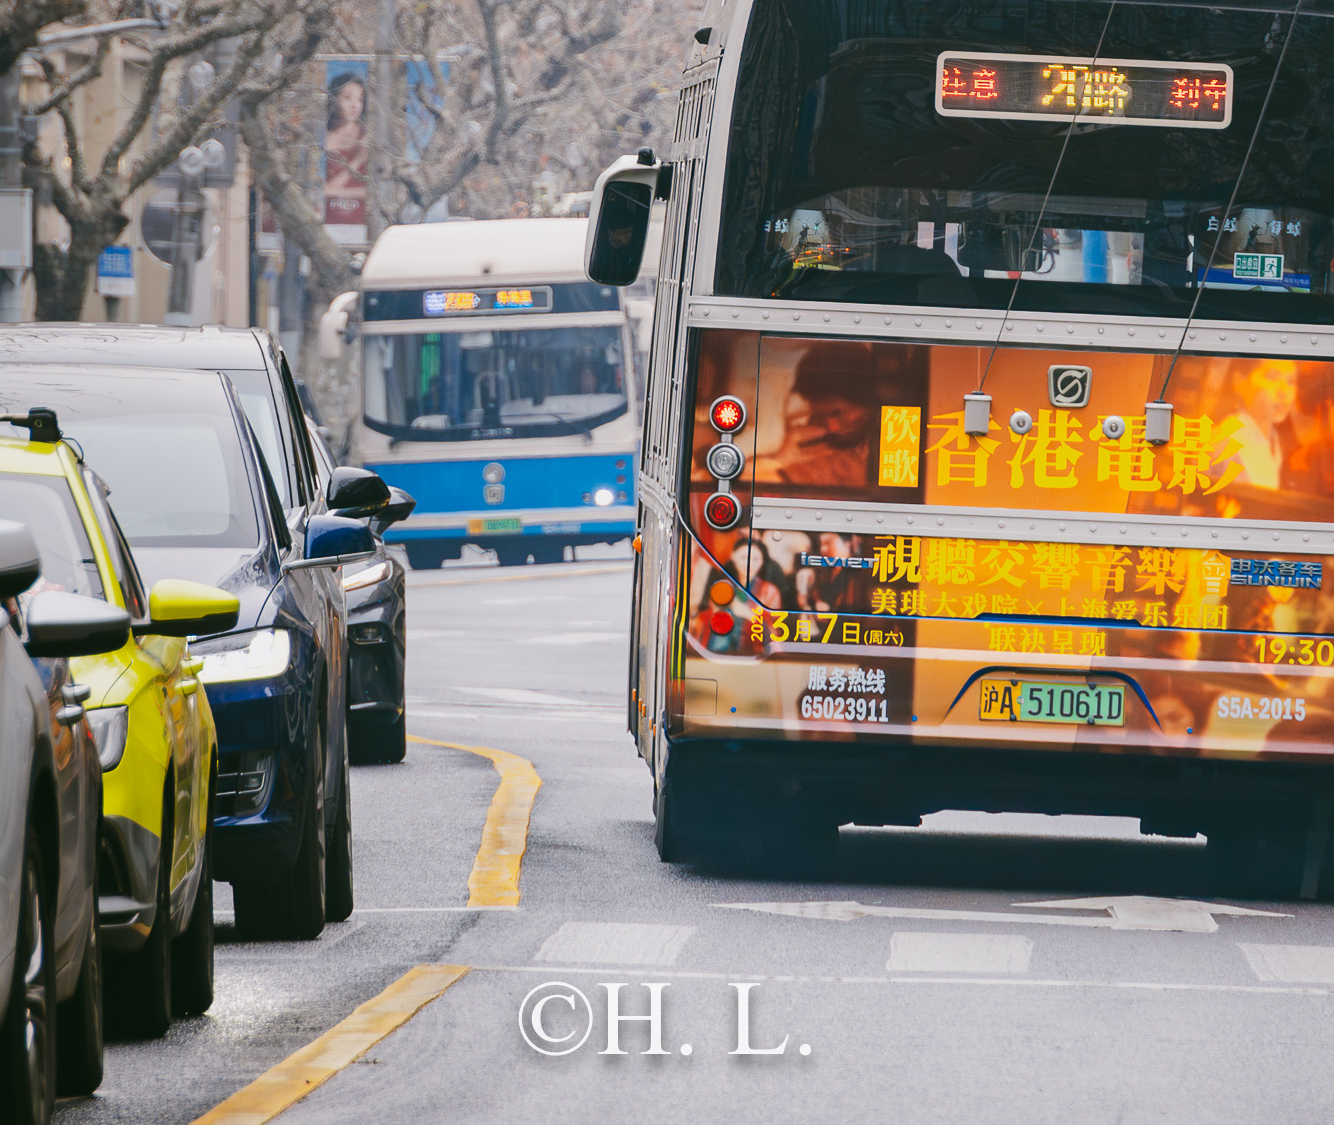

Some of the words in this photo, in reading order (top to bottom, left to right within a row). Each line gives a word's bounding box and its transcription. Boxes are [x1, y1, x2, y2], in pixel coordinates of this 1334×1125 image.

[881, 408, 919, 485] 饮歌
[925, 407, 1246, 496] 香港電影
[872, 535, 1233, 597] 視聽交響音樂會
[1230, 558, 1322, 577] 申沃客车
[1230, 575, 1322, 589] SUNWIN
[750, 606, 764, 643] 2026
[988, 626, 1106, 657] 联袂呈现
[1255, 638, 1334, 667] 19:30
[807, 665, 887, 695] 服务热线
[801, 695, 889, 723] 65023911
[1217, 695, 1307, 723] S5A-2015
